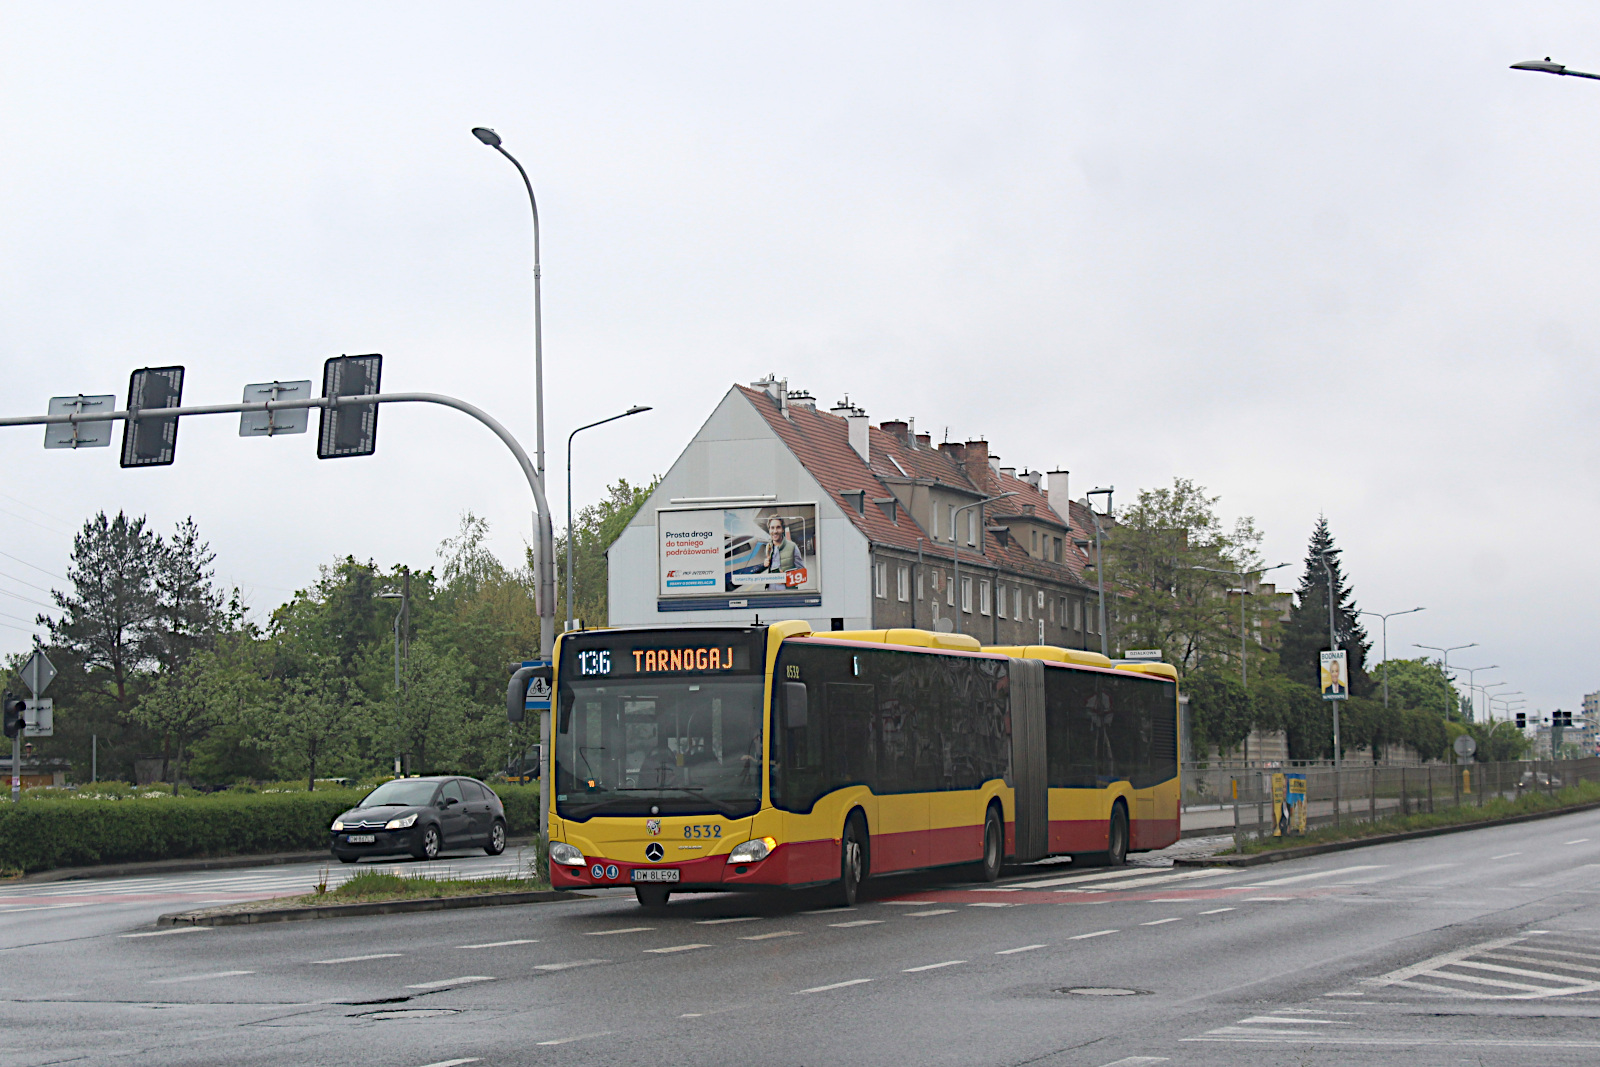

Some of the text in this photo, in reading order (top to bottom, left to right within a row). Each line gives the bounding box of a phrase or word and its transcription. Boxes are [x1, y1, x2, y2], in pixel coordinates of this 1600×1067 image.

[665, 531, 713, 540] Prosta droga
[677, 540, 704, 549] taniego
[666, 547, 719, 557] podróżowania!
[789, 572, 803, 585] 19
[578, 647, 733, 675] 136 TARNOGAJ
[1321, 652, 1344, 660] BODNAR
[786, 665, 800, 679] 8532
[683, 824, 722, 839] 8532
[636, 870, 678, 880] DW 8LE96
